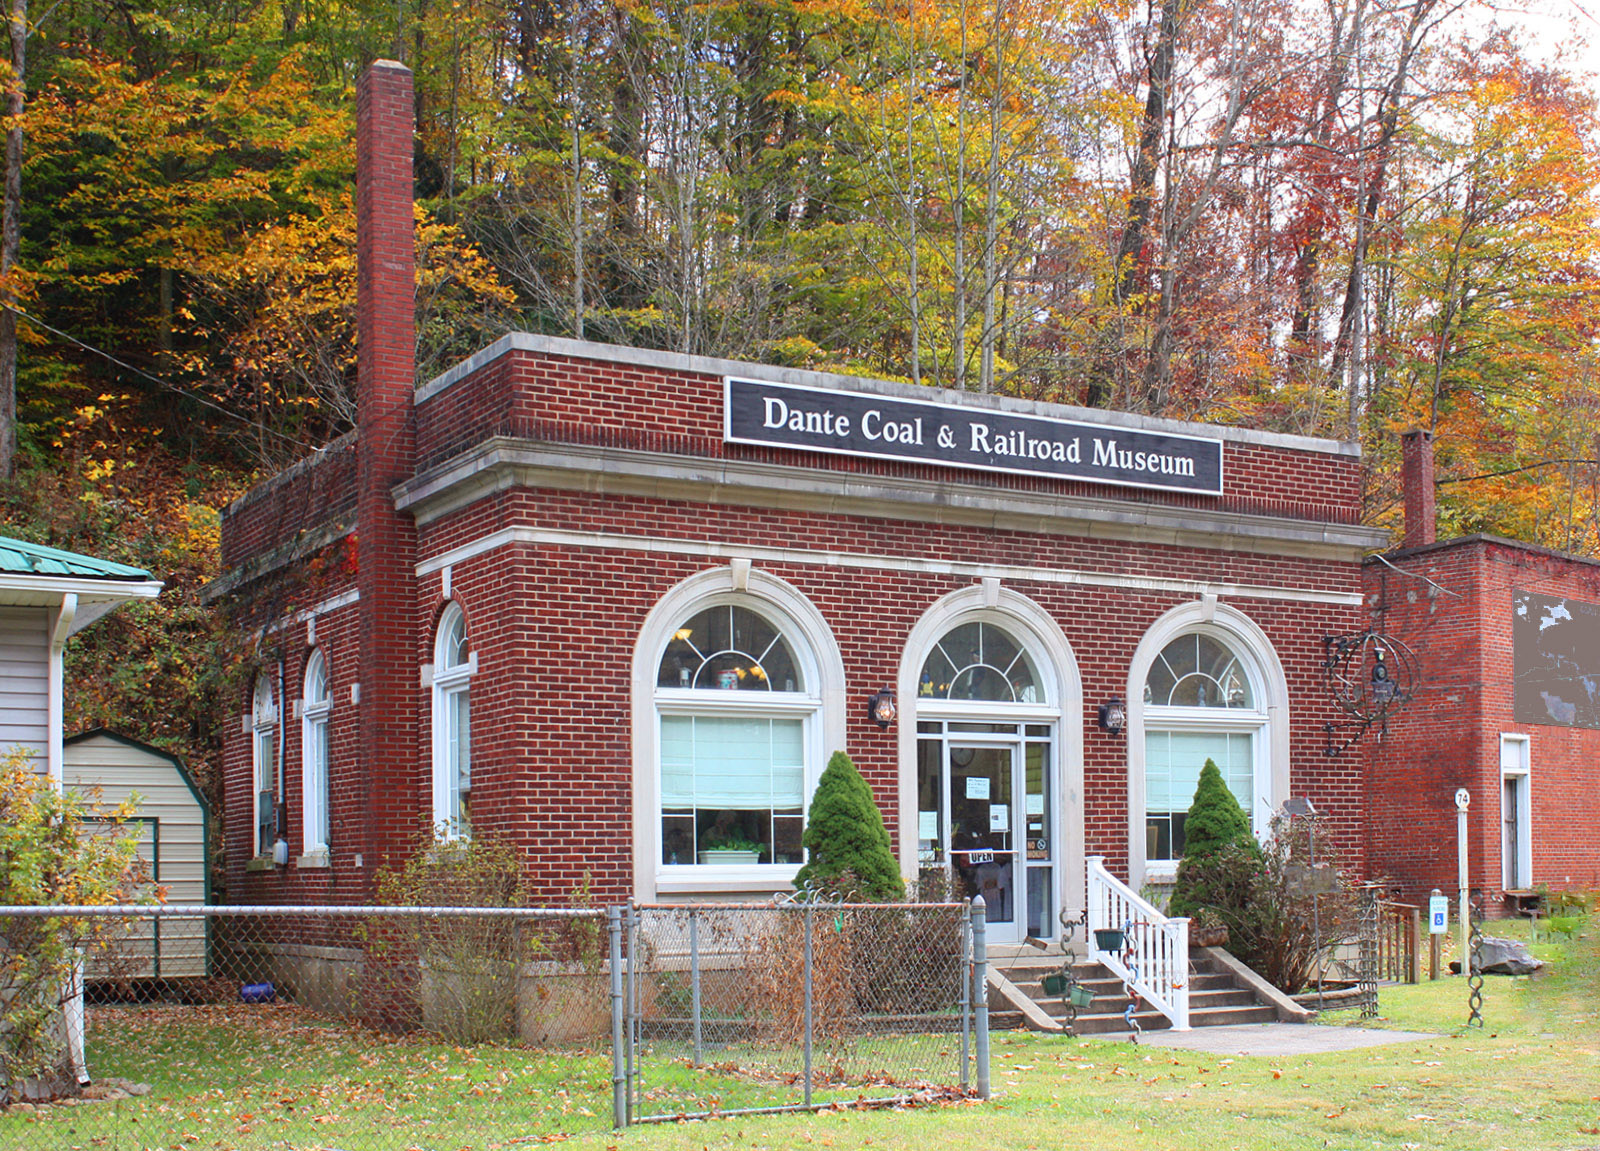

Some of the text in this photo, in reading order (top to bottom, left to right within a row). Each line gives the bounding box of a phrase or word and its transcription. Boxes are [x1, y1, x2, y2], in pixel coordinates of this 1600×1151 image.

[762, 397, 1195, 477] Dante Coal & Railroad Museum
[1458, 794, 1468, 803] 74
